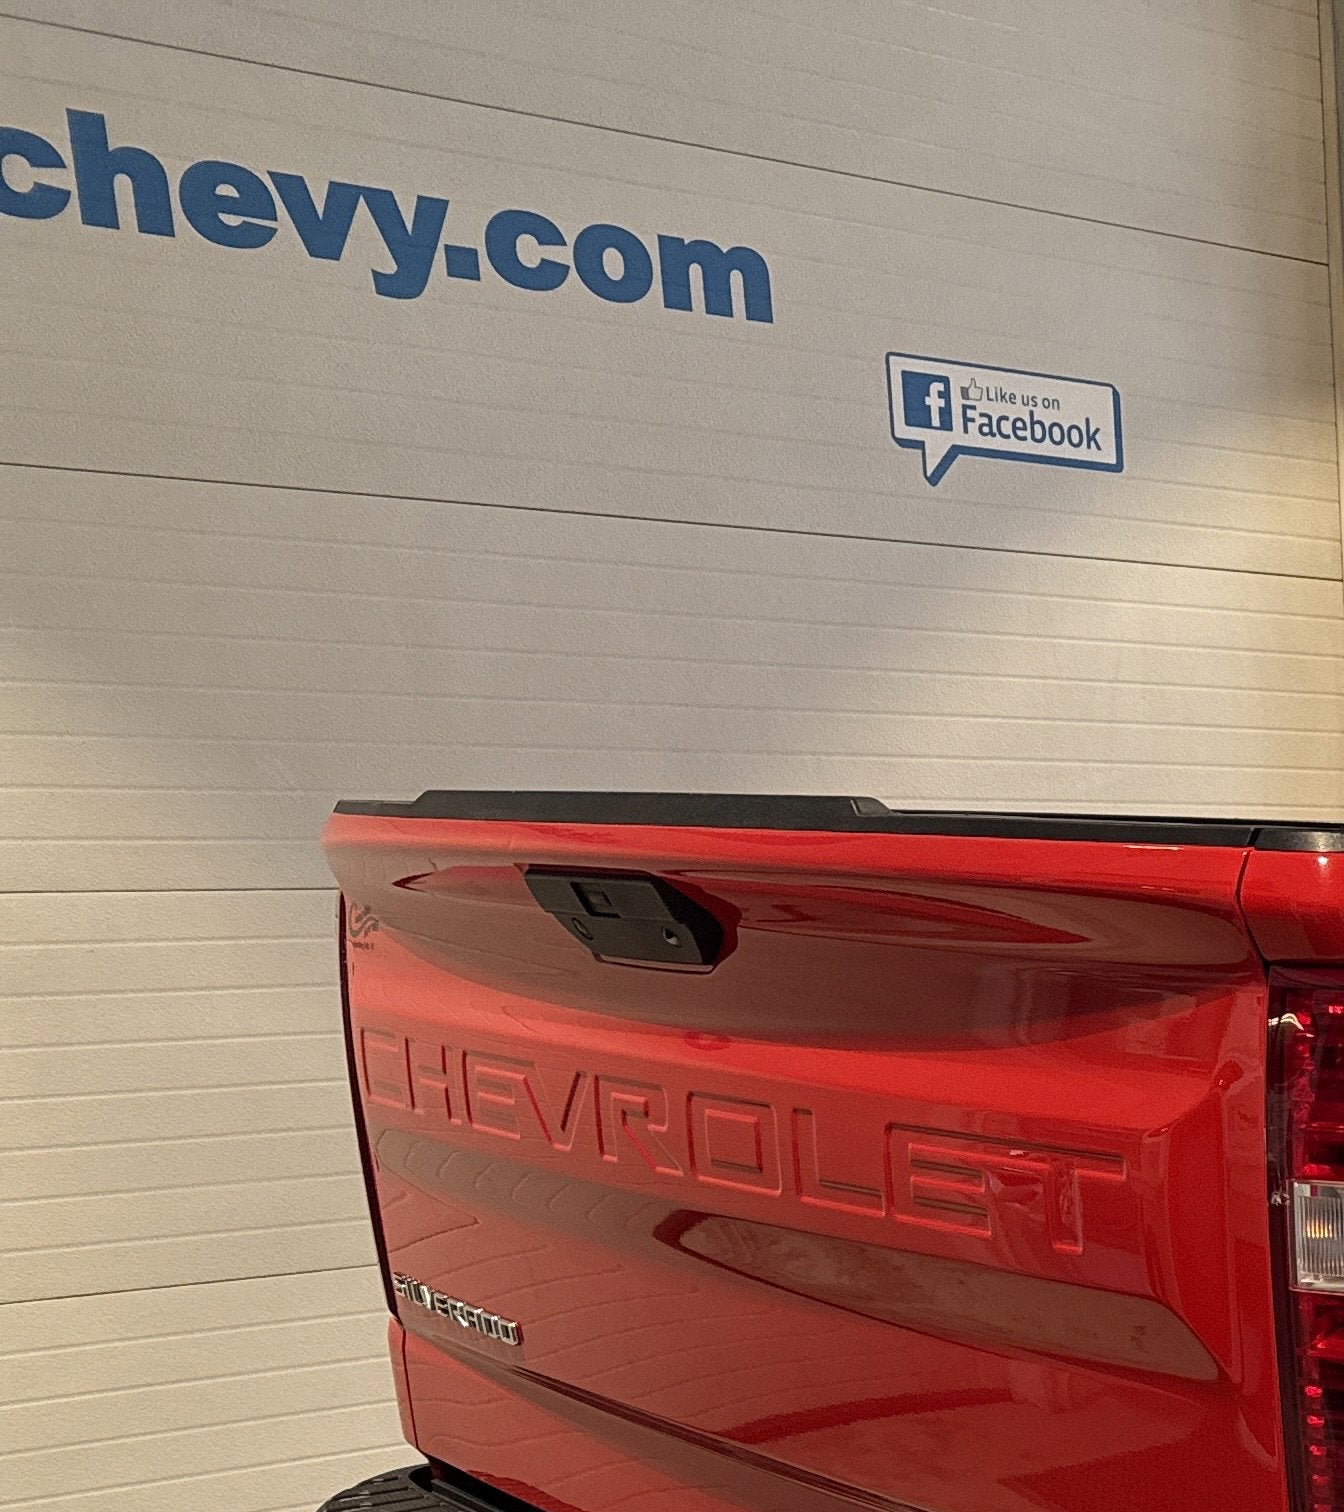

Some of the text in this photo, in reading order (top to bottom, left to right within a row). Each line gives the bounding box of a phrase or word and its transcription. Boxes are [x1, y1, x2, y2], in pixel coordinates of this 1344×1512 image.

[0, 108, 775, 324] chevy.com
[962, 404, 1102, 451] Facebook
[986, 386, 1060, 411] Like us on
[360, 1026, 1126, 1254] CHEVROLET
[393, 1271, 522, 1345] SILVERADO
